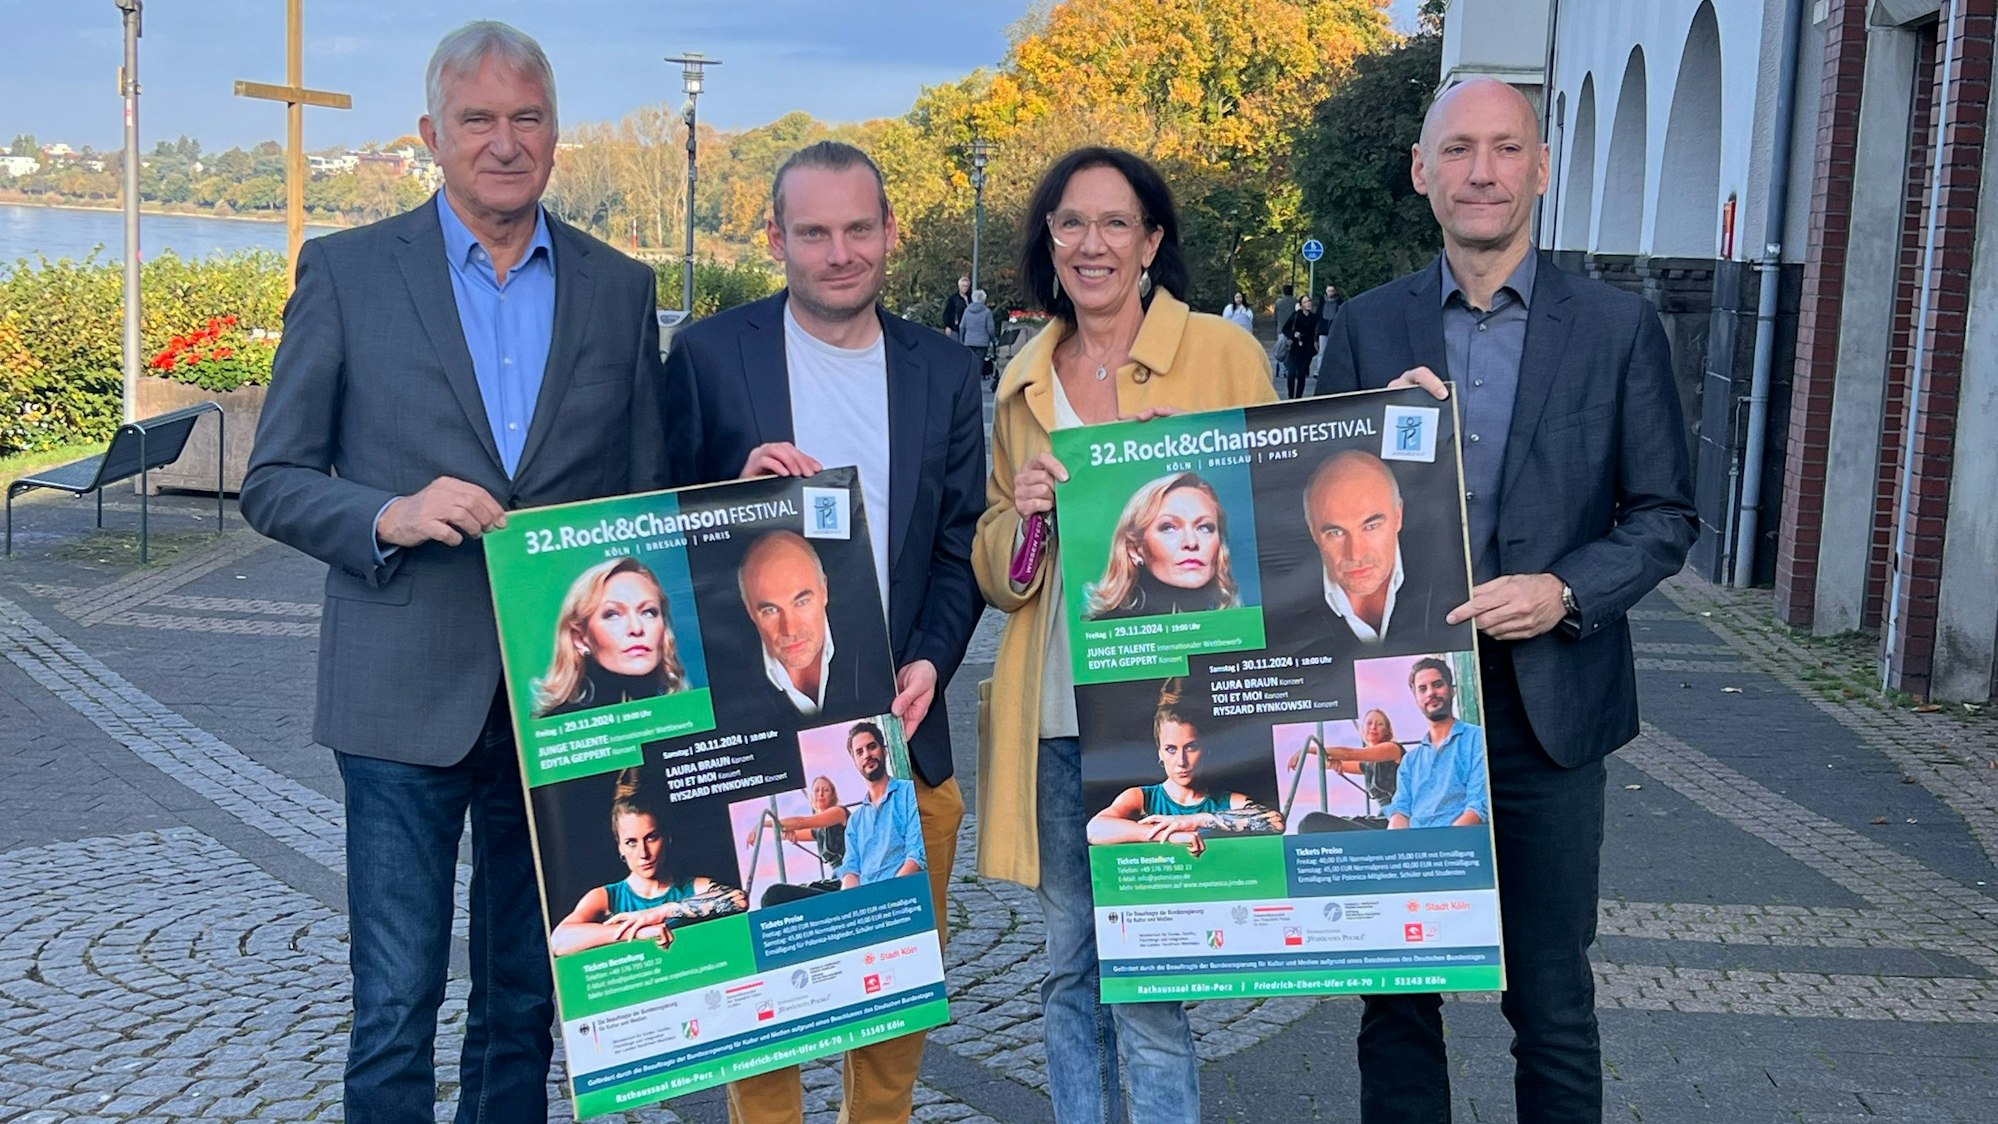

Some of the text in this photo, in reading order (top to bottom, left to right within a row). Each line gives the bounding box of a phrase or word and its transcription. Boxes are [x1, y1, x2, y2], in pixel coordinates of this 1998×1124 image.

[1299, 417, 1376, 443] FESTIVAL
[1166, 449, 1298, 472] KÖLN BRESLAU PARIS
[729, 499, 798, 525] FESTIVAL
[605, 530, 731, 558] KÖLN BRESLAU PARIS
[1085, 630, 1106, 640] Freitag
[1114, 623, 1163, 637] 29.11.2024
[1188, 622, 1200, 630] Uhr
[1086, 636, 1242, 658] JUNGE TALENTE Internationaler Wettbewerb
[1088, 655, 1182, 670] EDYTA GEPPERT Konzert
[1208, 663, 1236, 674] Samstag
[1242, 656, 1293, 670] 30.11.2024
[1319, 655, 1332, 664] Uhr
[1210, 676, 1304, 691] LAURA BRAUN Konzert
[1211, 691, 1288, 704] TOI ET MOI Konzert
[1212, 699, 1338, 716] RYSZARD RYNKOWSKI Konzert
[564, 713, 614, 733] 29.11.2024
[640, 709, 652, 718] Uhr
[538, 742, 568, 757] JUNGE
[568, 734, 609, 751] TALENTE
[662, 747, 689, 760] Samstag
[693, 733, 742, 753] 30.11.2024
[766, 729, 778, 738] Uhr
[540, 755, 570, 770] EDYTA
[570, 746, 612, 764] GEPPERT
[665, 753, 754, 778] LAURA BRAUN Konzert
[667, 768, 741, 790] TOI ET MOI Konzert
[669, 771, 787, 803] RYSZARD RYNKOWSKI Konzert
[1117, 854, 1175, 865] Tickets Bestellung
[1295, 846, 1343, 856] Tickets Preise
[1425, 900, 1470, 911] Stadt Köln
[760, 914, 803, 930] Tickets Preise
[880, 944, 917, 960] Stadt Köln
[583, 960, 608, 973] Tickets
[1137, 974, 1446, 994] Rathaussaal Köln-Porz Friedrich-Ebert-Ufer 64-70 51143 Köln
[615, 1081, 668, 1103] Rathaussaal
[670, 1069, 713, 1088] Köln-Porz
[732, 1041, 816, 1072] Friedrich-Ebert-Ufer
[860, 1023, 885, 1037] 51143
[886, 1018, 905, 1031] Köln
